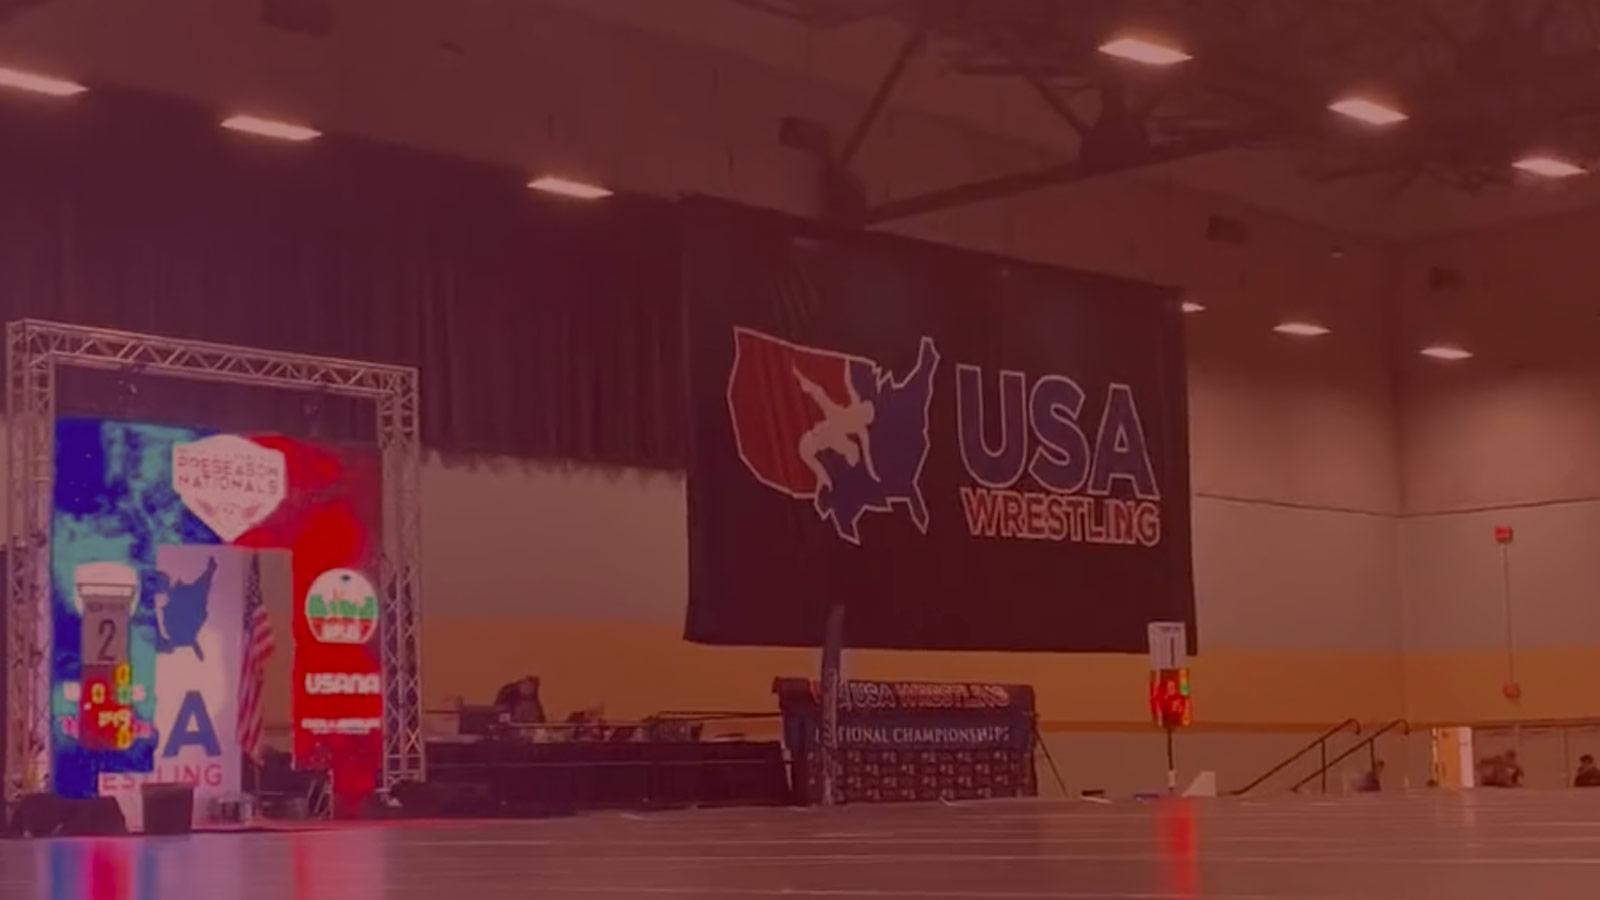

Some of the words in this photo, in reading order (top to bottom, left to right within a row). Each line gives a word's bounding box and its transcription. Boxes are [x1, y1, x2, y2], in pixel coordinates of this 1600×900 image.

[956, 363, 1161, 500] USA
[177, 456, 279, 478] PRESEASON
[177, 474, 278, 495] NATIONALS
[960, 487, 1161, 546] WRESTLING
[98, 619, 117, 661] 2
[305, 672, 380, 695] USANA
